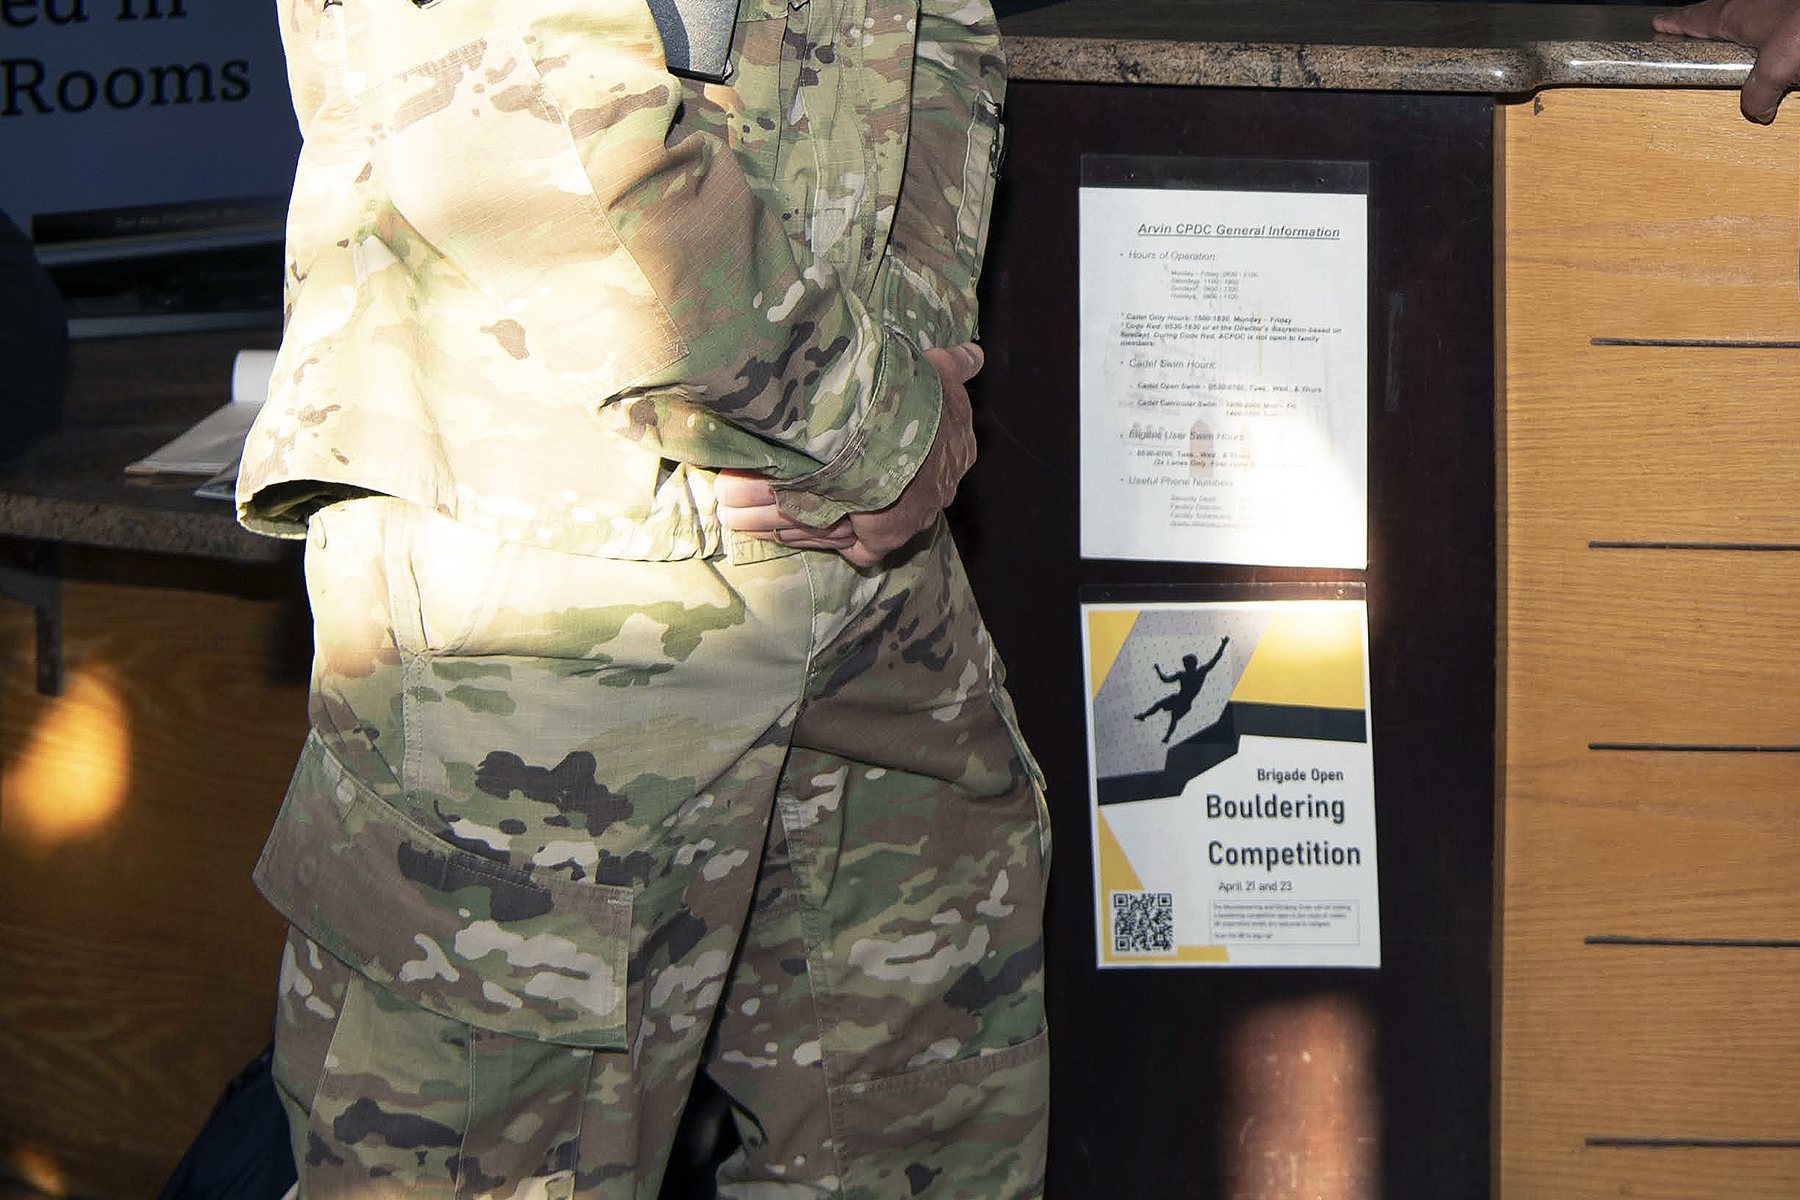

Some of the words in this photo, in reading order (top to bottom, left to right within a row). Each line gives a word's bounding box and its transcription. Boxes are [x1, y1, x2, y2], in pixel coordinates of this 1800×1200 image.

[0, 58, 251, 117] Rooms
[1138, 223, 1172, 235] Arvin
[1176, 223, 1212, 235] CPDC
[1216, 224, 1265, 236] General
[1269, 224, 1340, 238] Information
[1128, 250, 1157, 260] Hours
[1159, 250, 1169, 260] of
[1234, 316, 1262, 324] Monday
[1128, 476, 1158, 486] Useful
[1257, 768, 1307, 784] Brigade
[1311, 768, 1344, 784] Open
[1206, 793, 1345, 825] Bouldering
[1208, 840, 1361, 872] Competition
[1218, 881, 1243, 893] April
[1246, 881, 1256, 891] 21
[1259, 881, 1277, 891] and
[1280, 881, 1293, 891] 23
